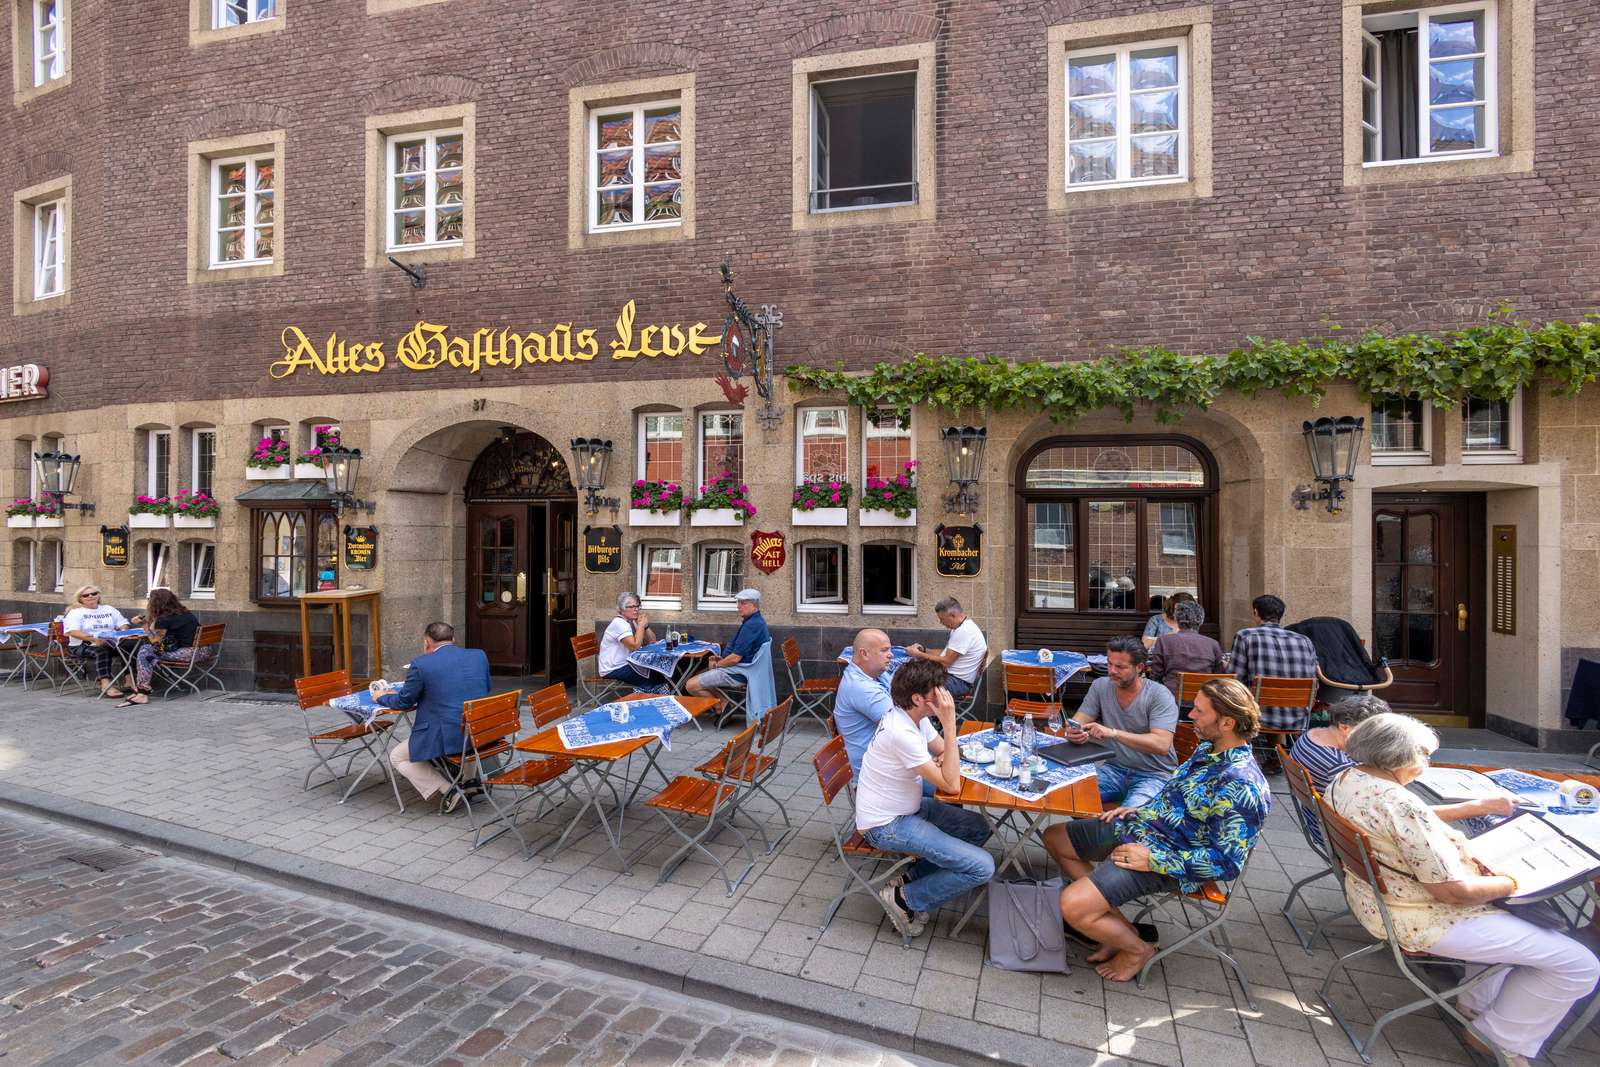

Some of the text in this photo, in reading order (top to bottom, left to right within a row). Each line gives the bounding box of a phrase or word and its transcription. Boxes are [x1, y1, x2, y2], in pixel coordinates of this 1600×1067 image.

[269, 326, 385, 378] Altes
[608, 299, 722, 360] Leve
[473, 399, 486, 411] 37
[588, 545, 620, 556] Bitburger
[939, 547, 978, 557] Krombacher
